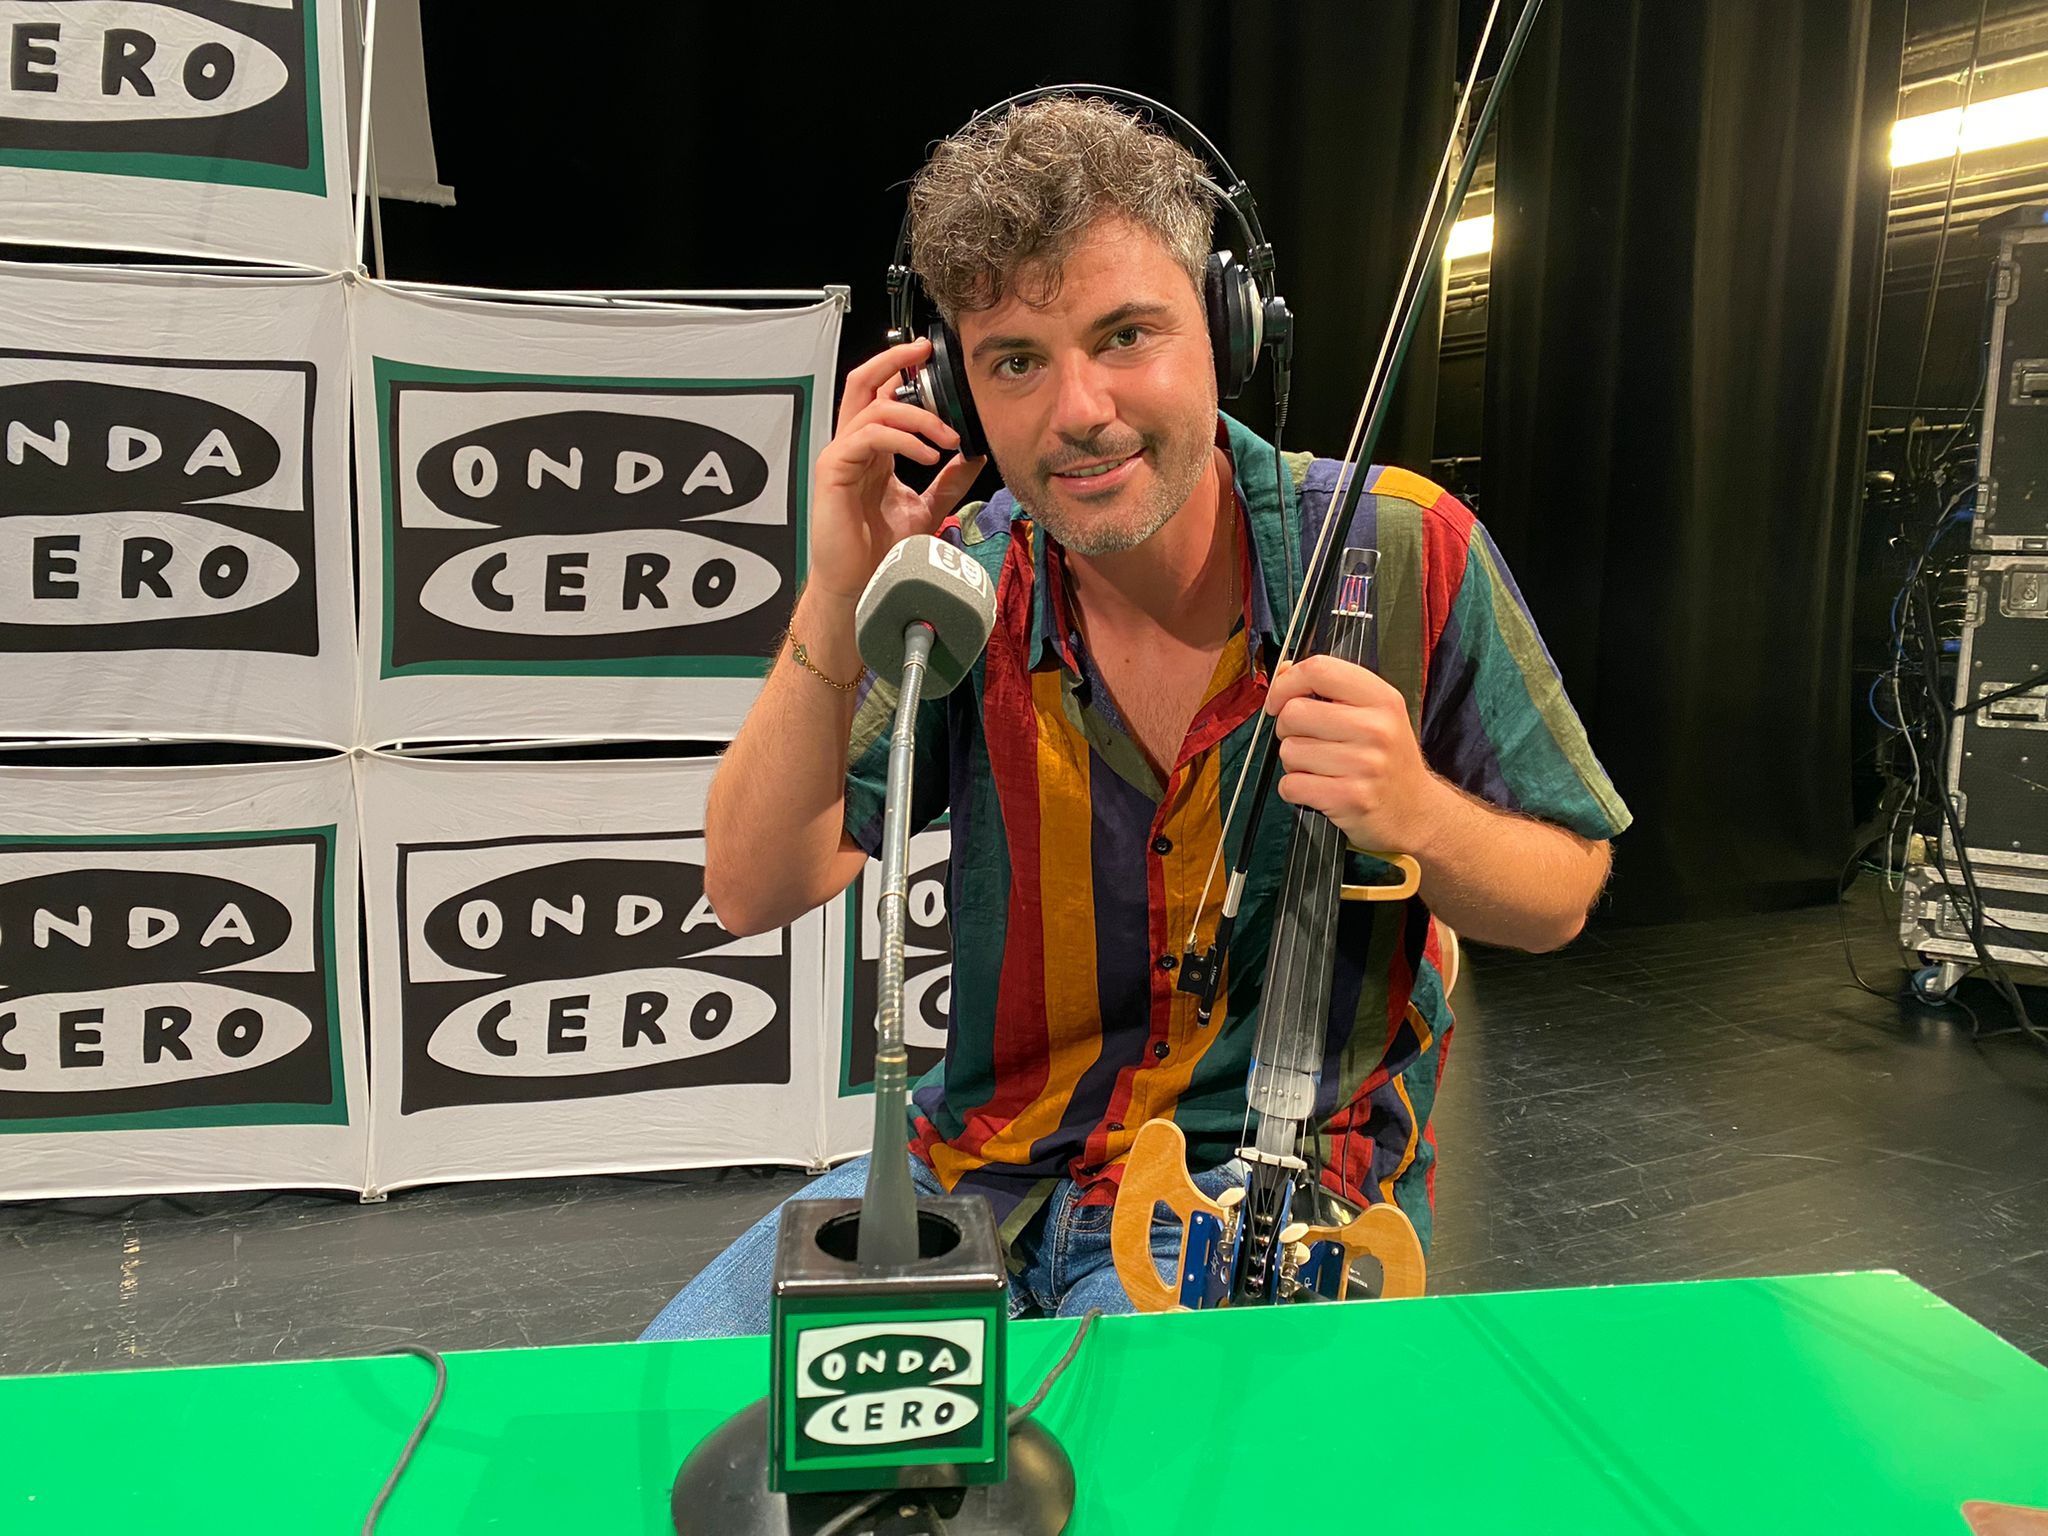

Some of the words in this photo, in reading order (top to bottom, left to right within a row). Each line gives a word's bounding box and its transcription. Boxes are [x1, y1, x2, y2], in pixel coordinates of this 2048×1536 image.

[452, 445, 734, 498] ONDA
[471, 552, 737, 612] CERO
[0, 902, 256, 949] NDA
[458, 892, 728, 950] ONDA
[0, 1005, 264, 1071] CERO
[476, 990, 733, 1057] CERO
[821, 1347, 956, 1381] ONDA
[831, 1400, 955, 1433] CERO
